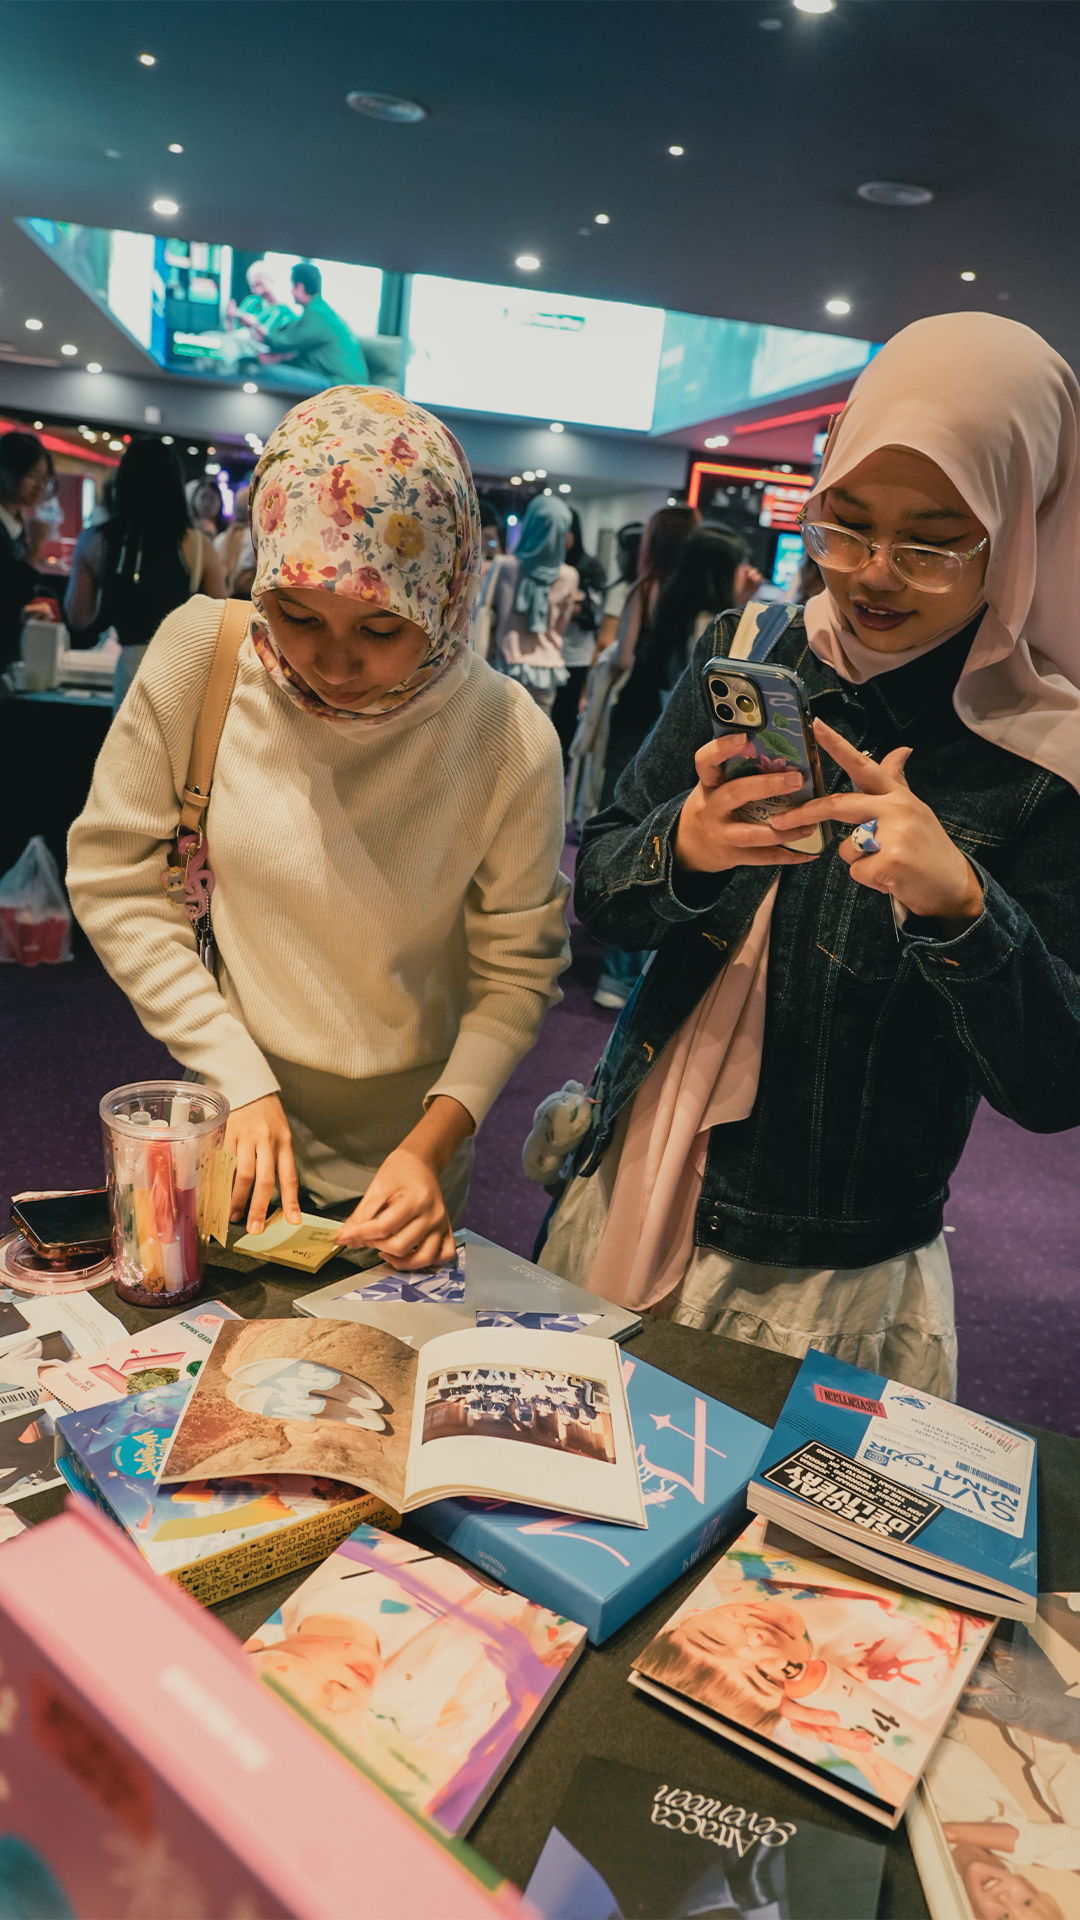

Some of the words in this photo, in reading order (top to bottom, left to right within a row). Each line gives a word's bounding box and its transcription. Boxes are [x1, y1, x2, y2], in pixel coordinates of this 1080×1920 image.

[823, 1390, 879, 1414] SEVENTEEN
[911, 1417, 970, 1444] SEVENTEEN
[799, 1457, 831, 1475] JOSHUA
[801, 1453, 828, 1469] WOOZI
[815, 1448, 836, 1460] DINO
[828, 1460, 841, 1469] DK
[833, 1469, 870, 1491] WONWOO
[840, 1460, 873, 1480] VERNON
[845, 1468, 878, 1488] MINGYU
[783, 1465, 911, 1534] DELIVERY
[834, 1476, 878, 1500] JEONGHAN
[875, 1491, 902, 1507] HOSHI
[878, 1480, 929, 1508] SEUNGKWAN
[889, 1492, 906, 1503] THE
[921, 1475, 1017, 1523] SVT
[290, 1497, 376, 1537] ENTERTAINMENT
[787, 1474, 893, 1537] SPECIAL
[883, 1501, 920, 1522] S.COUPS
[906, 1506, 926, 1518] JUN
[225, 1536, 297, 1571] DISTRIBUTED
[298, 1531, 313, 1542] BY
[314, 1511, 361, 1535] HYBE/YG
[276, 1533, 327, 1558] WARNING:
[328, 1527, 349, 1538] ALL
[242, 1541, 326, 1580] UNAUTHORIZED
[478, 1550, 507, 1574] SEVENTEEN
[220, 1587, 231, 1597] IS
[653, 1783, 798, 1848] Seventeen
[650, 1802, 759, 1858] Attacca
